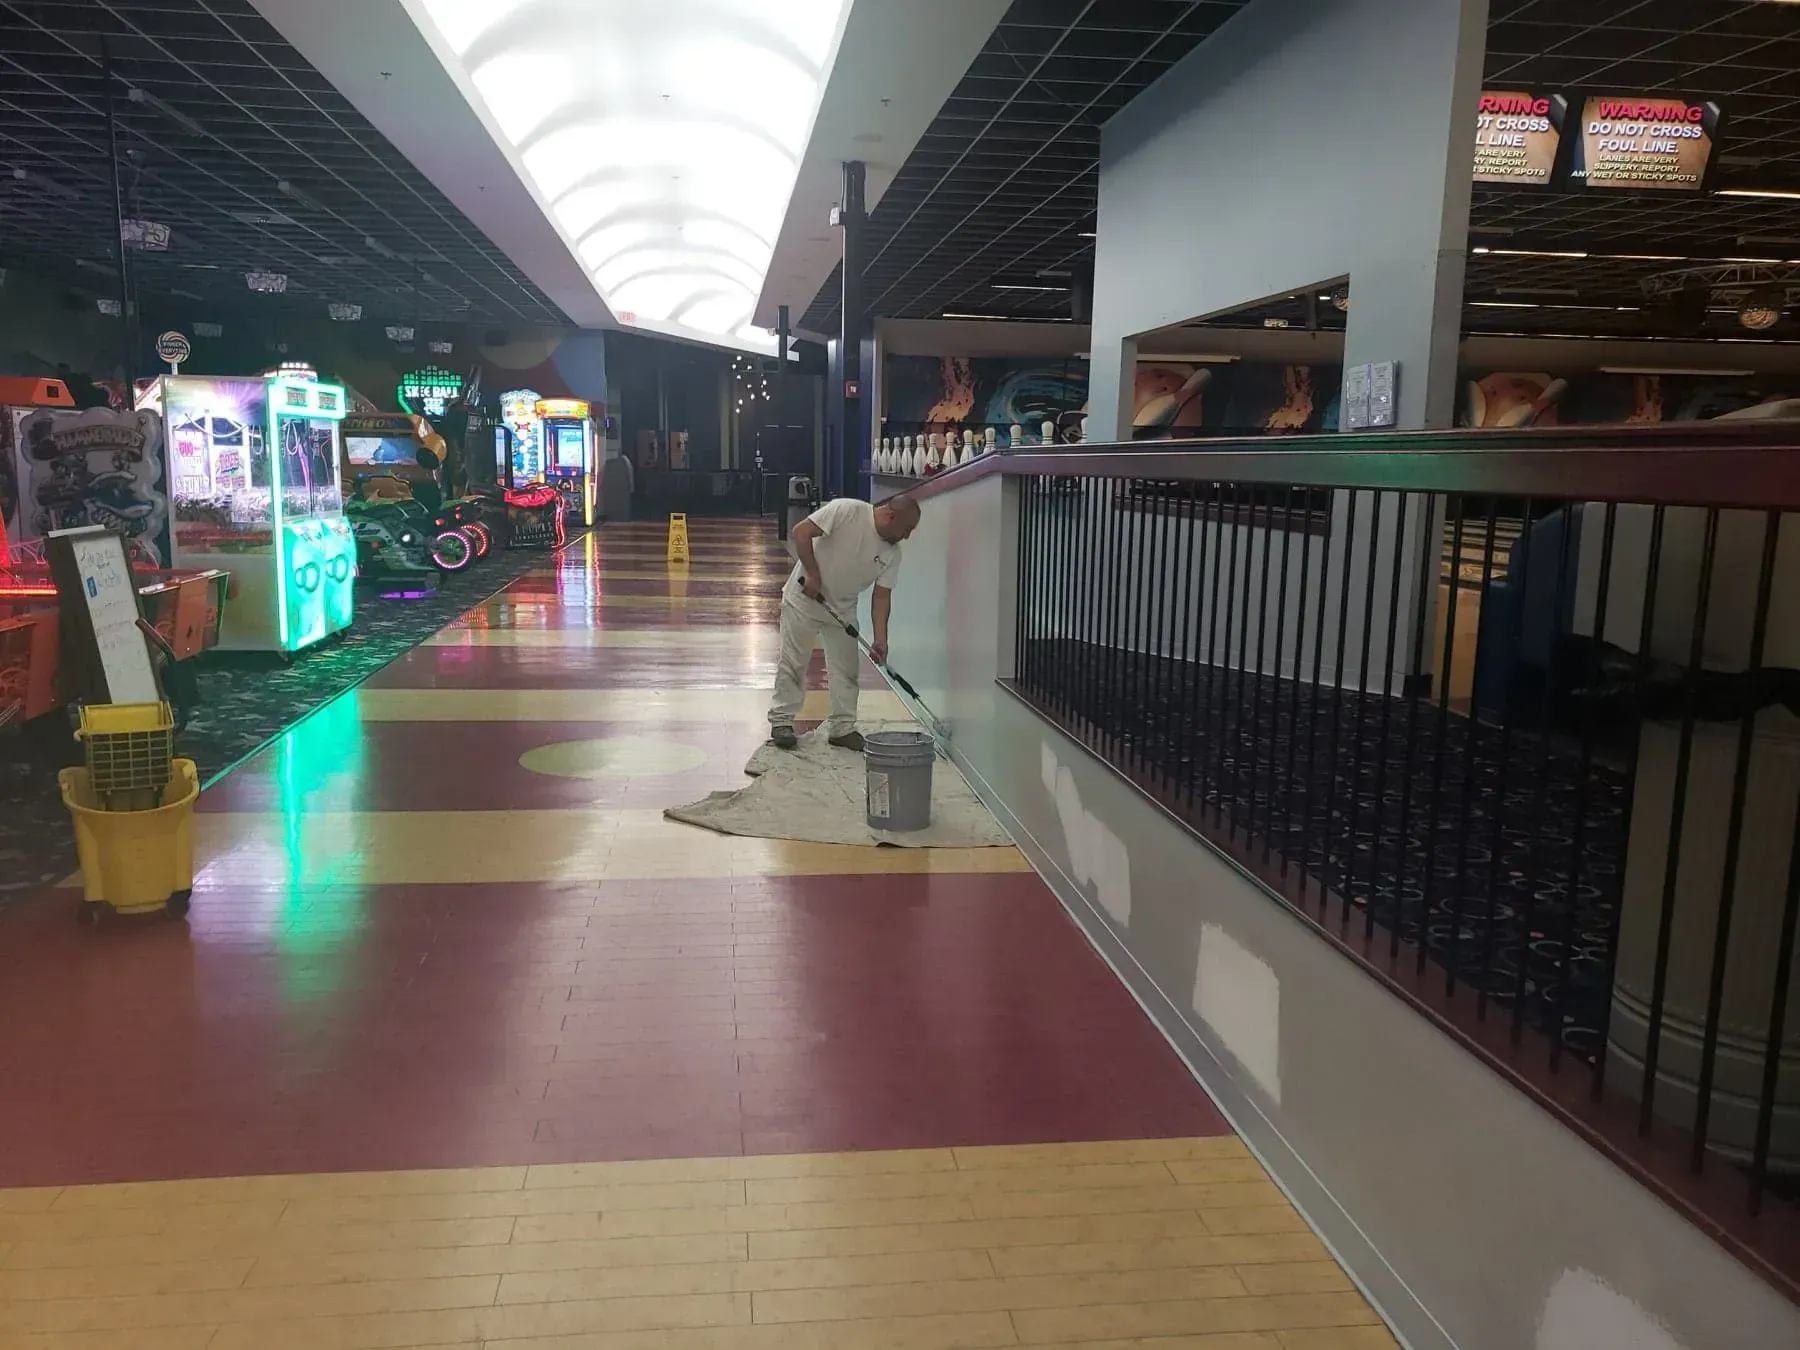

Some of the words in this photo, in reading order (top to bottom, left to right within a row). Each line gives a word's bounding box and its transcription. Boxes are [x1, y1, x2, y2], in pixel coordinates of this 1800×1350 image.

[1478, 95, 1550, 115] RNING
[1600, 101, 1704, 122] WARNING
[1496, 118, 1550, 131] CROSS
[1588, 122, 1612, 135] DO
[1614, 123, 1648, 136] NOT
[1650, 125, 1703, 138] CROSS
[1488, 134, 1527, 147] LINE.
[1598, 138, 1639, 152] FOUL
[1642, 140, 1680, 153] LINE.
[1489, 158, 1528, 166] REPORT
[1599, 153, 1631, 162] LANES
[1631, 155, 1653, 163] ARE
[1653, 156, 1679, 164] VERY
[1514, 168, 1546, 176] SPOTS
[1641, 164, 1680, 172] REPORT
[1570, 170, 1591, 178] ANY
[1592, 171, 1615, 179] WET
[1615, 171, 1630, 179] OR
[1630, 172, 1666, 181] STICKY
[1667, 174, 1698, 182] SPOTS
